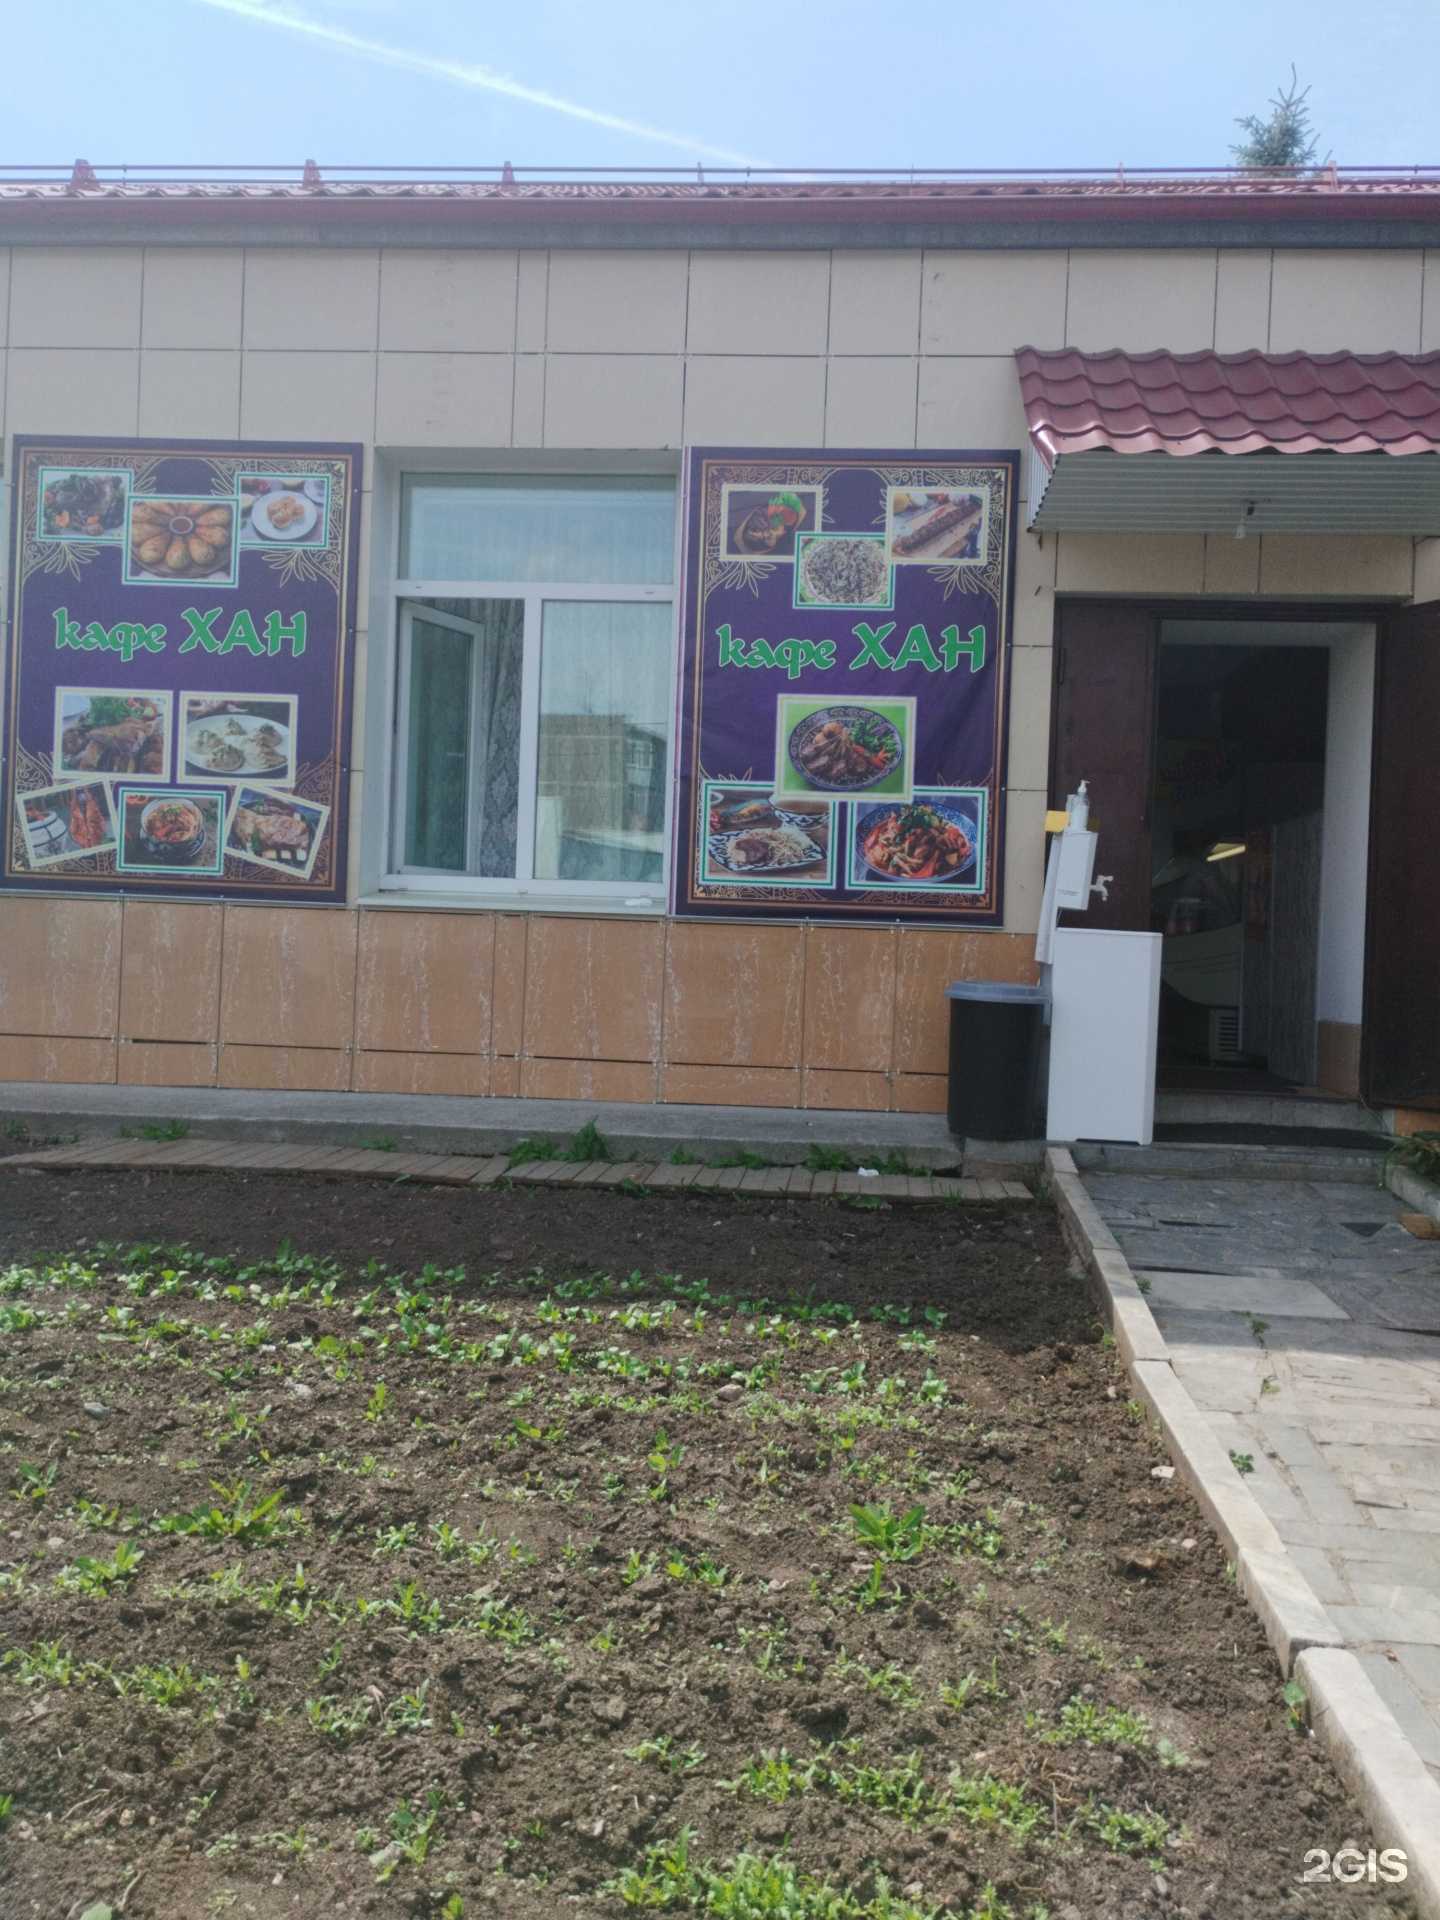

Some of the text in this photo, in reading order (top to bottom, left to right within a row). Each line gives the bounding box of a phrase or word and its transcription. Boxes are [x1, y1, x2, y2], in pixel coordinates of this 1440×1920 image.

[53, 607, 306, 662] кафе ХАН
[716, 622, 986, 680] кафе ХАН
